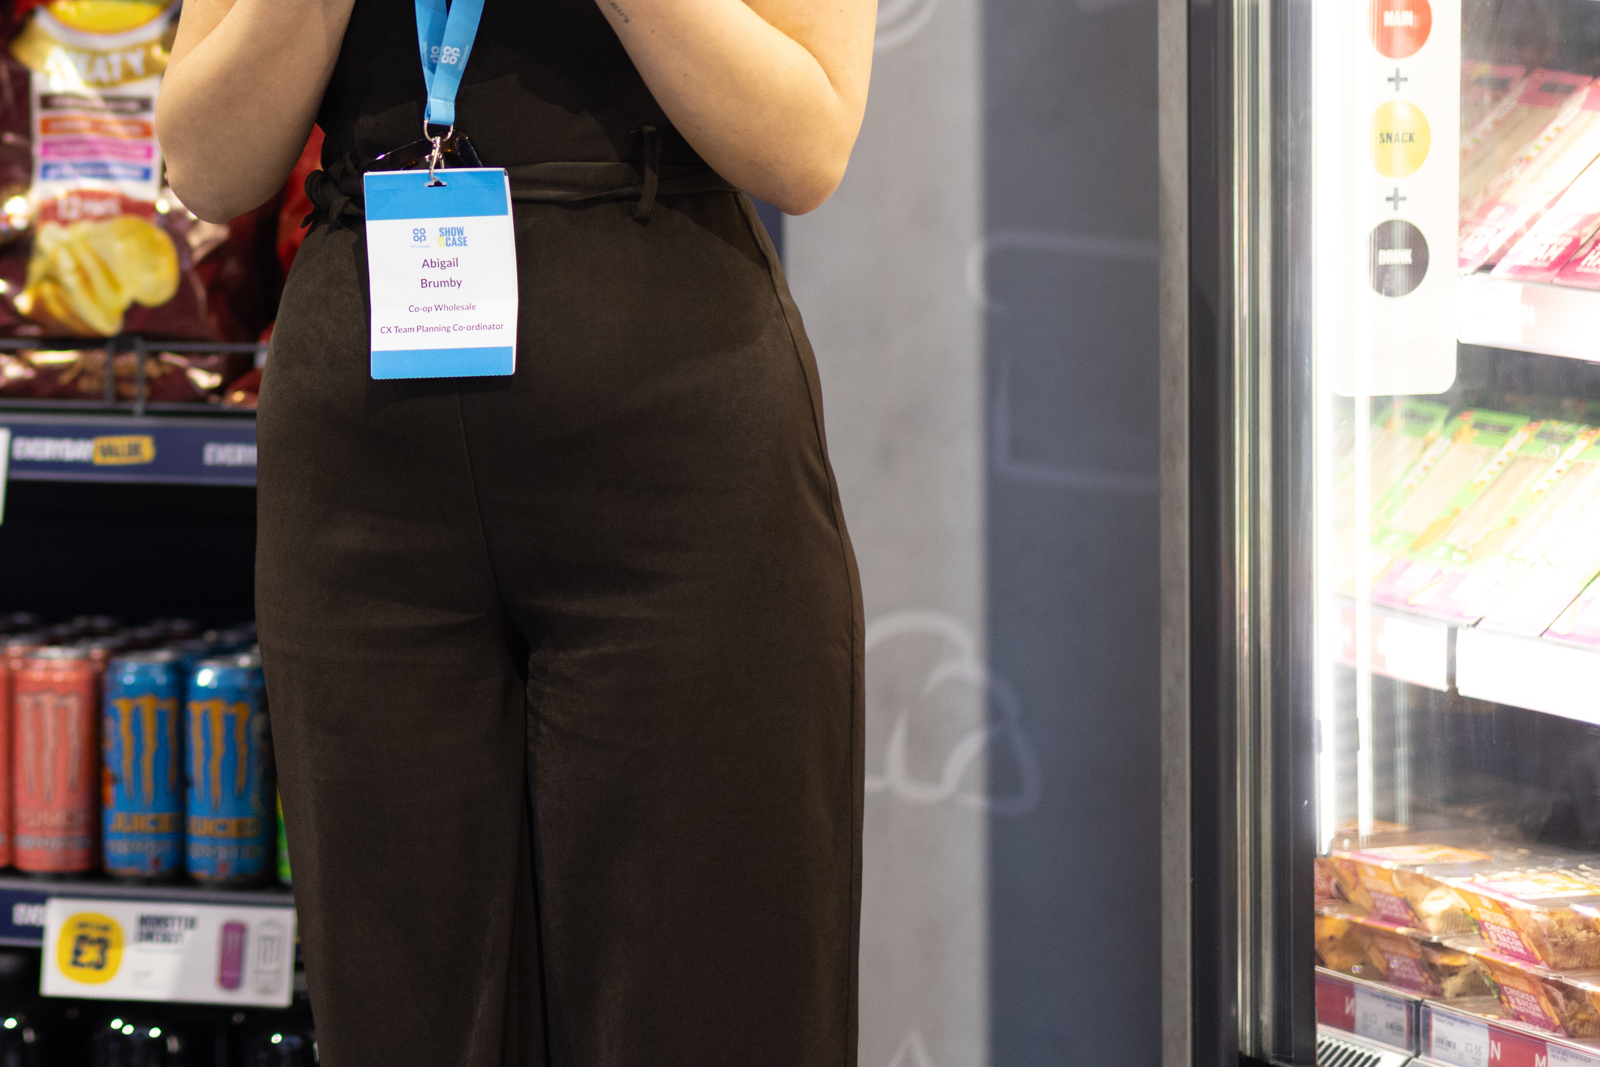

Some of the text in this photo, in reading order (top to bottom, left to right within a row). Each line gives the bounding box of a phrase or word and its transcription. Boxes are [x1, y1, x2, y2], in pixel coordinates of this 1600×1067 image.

[1384, 10, 1414, 28] MAIN
[1379, 132, 1415, 144] SNACK
[439, 226, 464, 237] SHOW
[445, 236, 468, 247] CASE
[421, 257, 459, 270] Abigail
[420, 277, 463, 289] Brumby
[408, 302, 477, 313] Co-op Wholesale
[380, 322, 504, 334] CX Team Planning Co-ordinator
[1503, 985, 1537, 1004] CHICKEN
